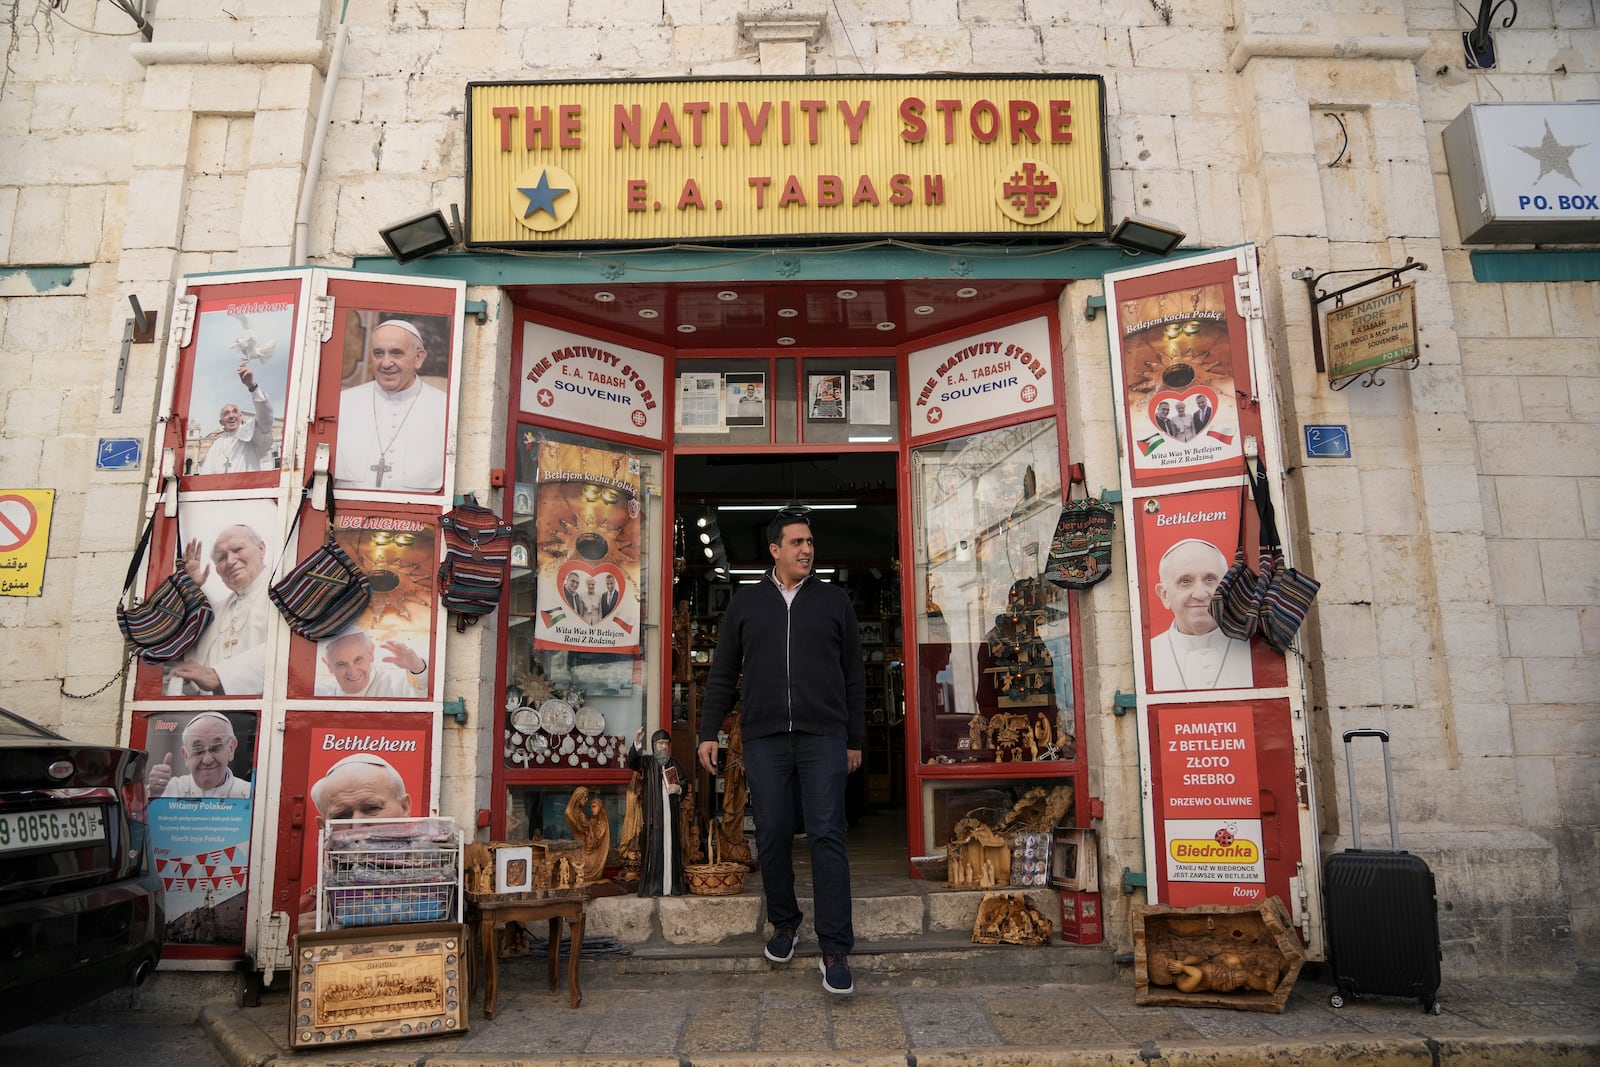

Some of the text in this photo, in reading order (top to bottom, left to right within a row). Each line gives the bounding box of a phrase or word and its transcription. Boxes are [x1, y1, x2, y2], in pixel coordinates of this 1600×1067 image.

[492, 97, 1073, 152] THE NATIVITY STORE
[748, 173, 945, 210] TABASH
[1558, 195, 1600, 210] BOX
[227, 301, 288, 316] Bethlehem
[1335, 291, 1404, 321] THE NATIVITY
[1126, 310, 1221, 334] Betlejem kocha Polskę
[1352, 309, 1385, 327] STORE
[1349, 334, 1369, 346] WOOD
[1391, 322, 1409, 332] PEARL
[1367, 334, 1399, 349] SOUVENIRS
[526, 357, 553, 384] THE
[552, 346, 621, 367] NATIVITY
[621, 365, 657, 411] STORE
[916, 377, 938, 407] THE
[936, 341, 1003, 378] NATIVITY
[1004, 343, 1047, 381] STORE
[972, 361, 1011, 380] TABASH
[588, 370, 626, 389] TABASH
[554, 380, 631, 405] SOUVENIR
[940, 376, 1018, 402] SOUVENIR
[1312, 430, 1321, 440] 2
[105, 443, 113, 453] 4
[1193, 446, 1222, 454] Betlejem
[544, 470, 638, 496] Betlejem kocha Polskę
[340, 515, 425, 532] Bethlehem
[1156, 510, 1228, 527] Bethlehem
[2, 579, 29, 592] ممنوع
[555, 626, 572, 634] Wita
[573, 627, 587, 635] Was
[597, 629, 625, 638] Betlejem
[1174, 722, 1237, 737] PAMIĄTKI
[322, 733, 417, 753] Bethlehem
[1168, 739, 1246, 752] Z BETLEJEM
[1186, 756, 1230, 768] ZŁOTO
[1183, 773, 1236, 785] SREBRO
[168, 801, 233, 811] Witamy Polaków
[1170, 797, 1253, 807] DRZEWO OLIWNE
[1176, 844, 1252, 858] Biedronka
[1232, 886, 1260, 899] Rony
